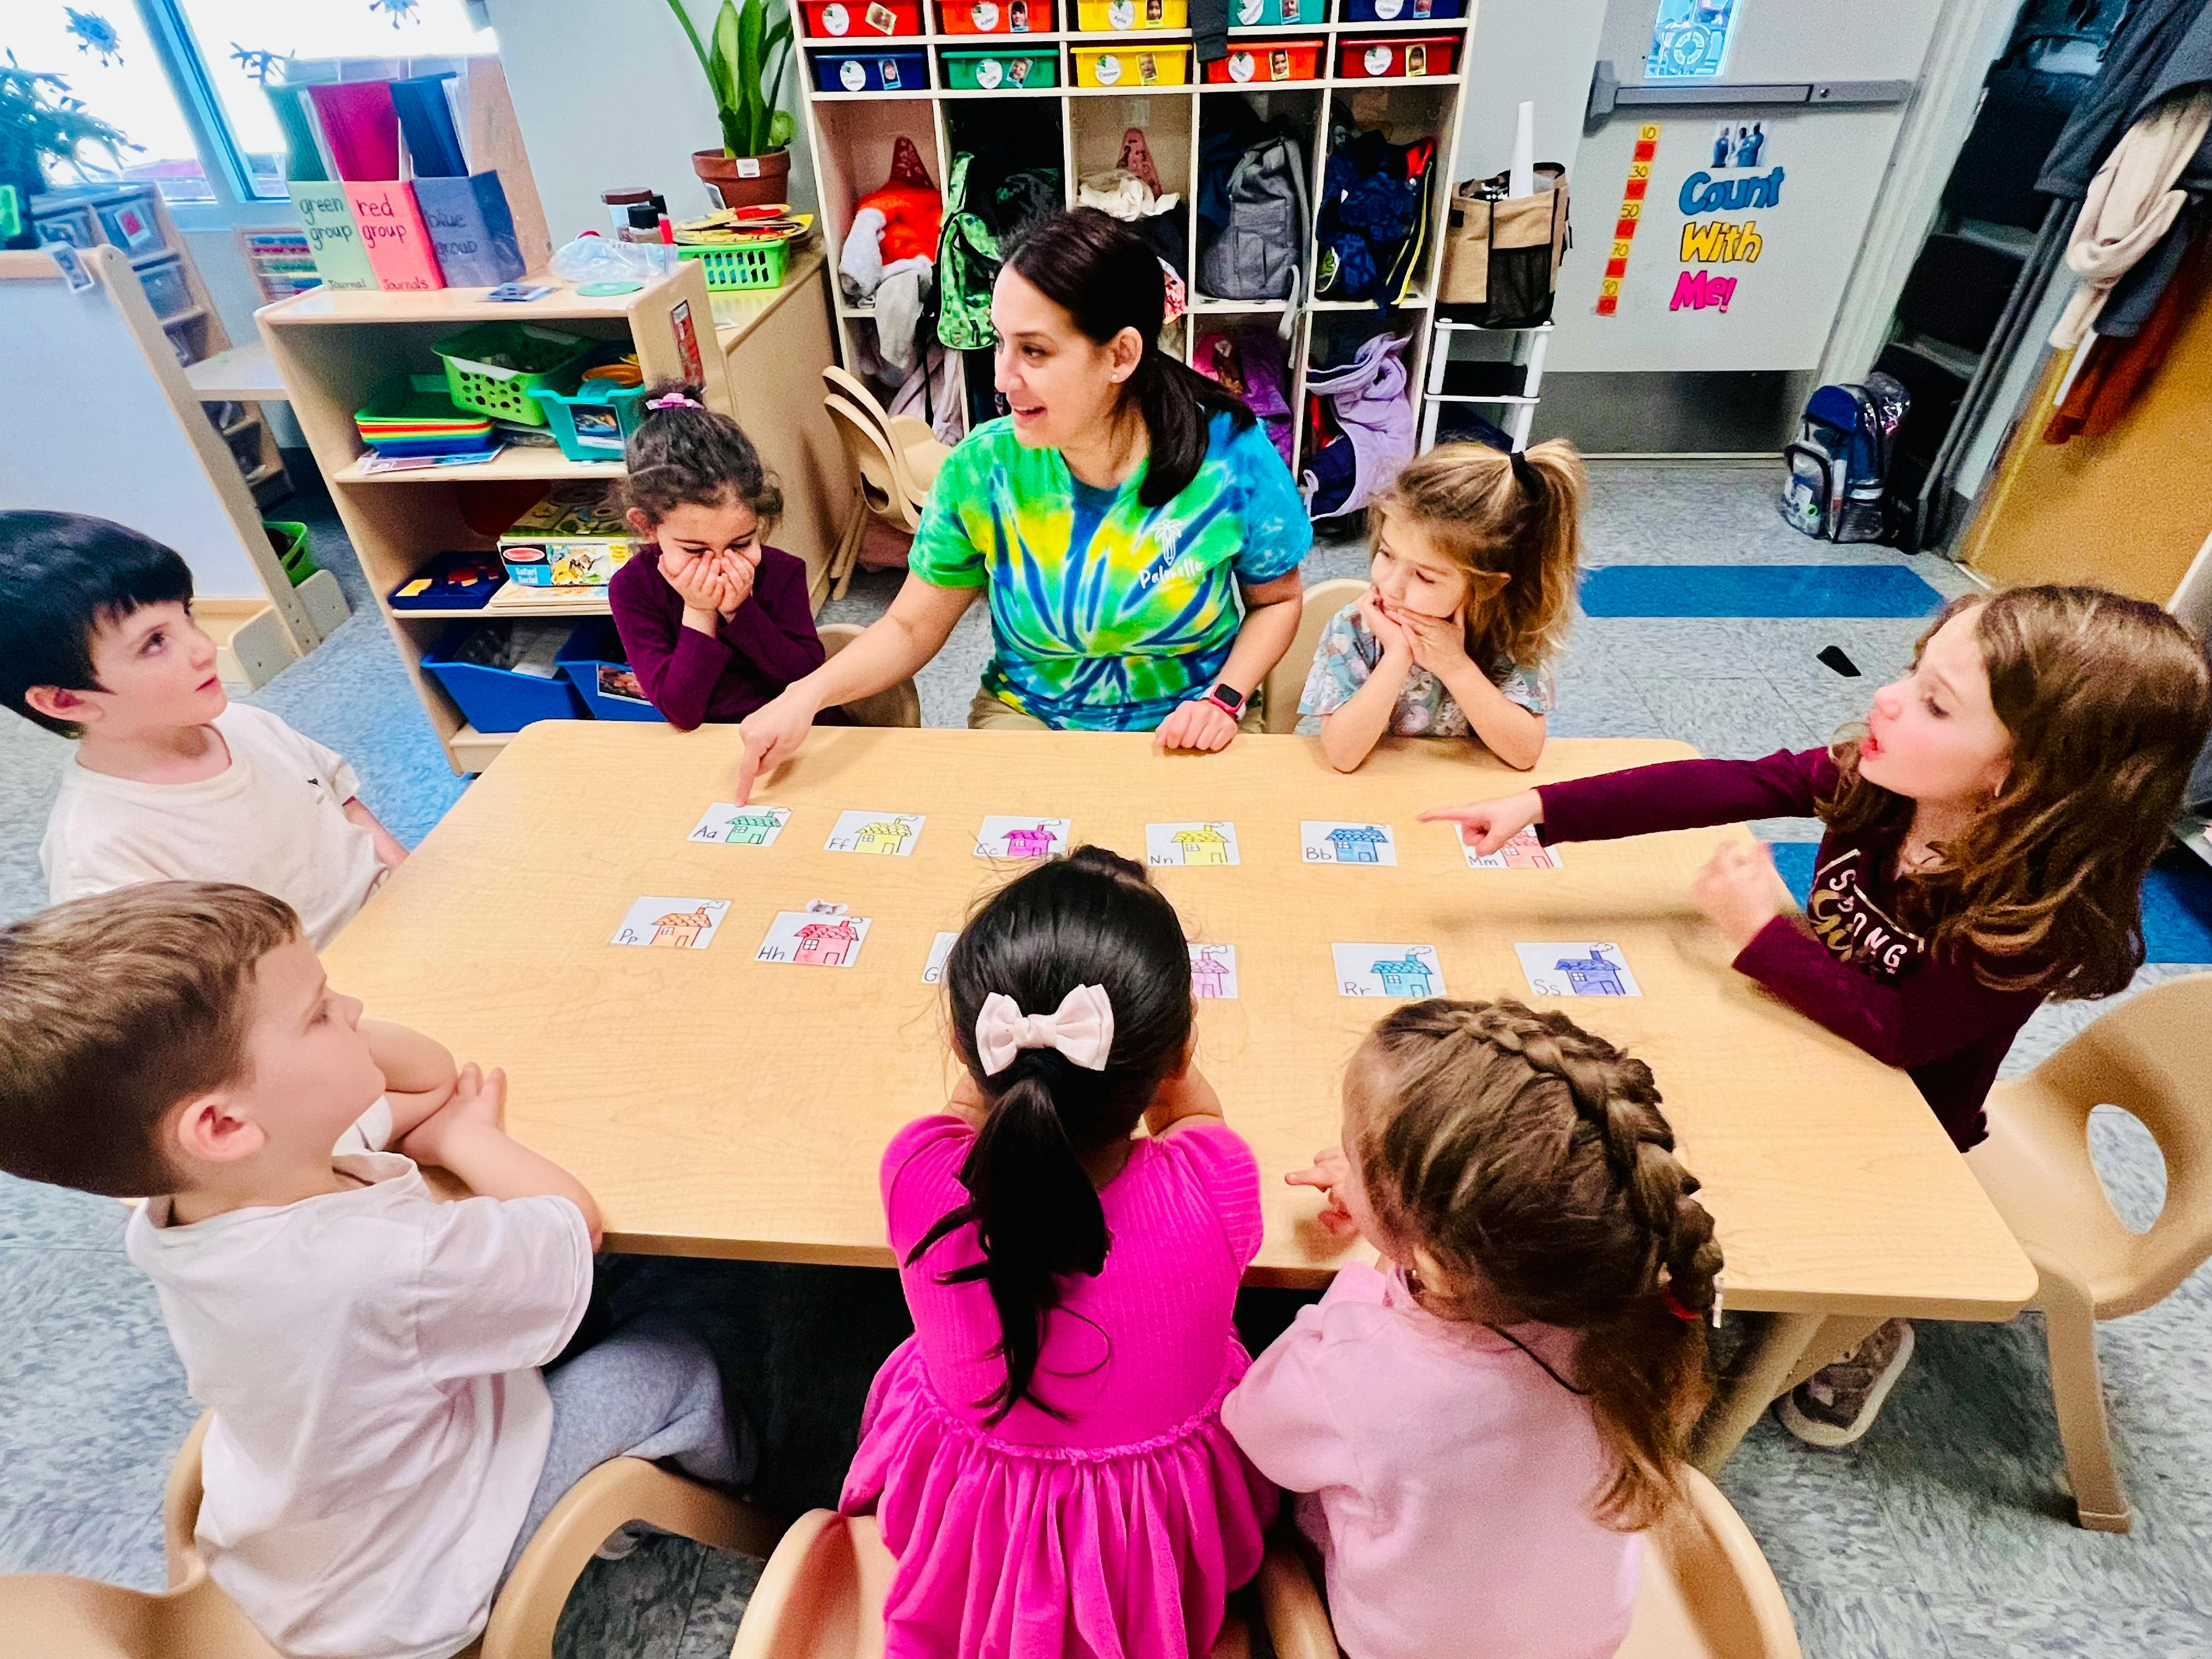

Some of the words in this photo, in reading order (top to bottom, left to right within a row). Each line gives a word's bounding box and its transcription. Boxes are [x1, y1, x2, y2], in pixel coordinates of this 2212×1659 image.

[1642, 126, 1656, 139] 10
[1628, 165, 1648, 177] 30
[1679, 166, 1785, 216] Count
[300, 196, 344, 226] green
[356, 193, 394, 217] red
[1621, 204, 1639, 218] 50
[309, 225, 353, 251] group
[363, 224, 407, 249] group
[1680, 221, 1763, 263] With
[1612, 242, 1629, 257] 70
[328, 278, 366, 290] Journal
[383, 276, 429, 291] Journals
[1602, 280, 1618, 296] 90
[1669, 270, 1737, 313] Me!
[1138, 557, 1204, 589] Palmetto
[692, 825, 718, 838] Aa
[828, 838, 850, 850] Ff
[977, 843, 998, 855] Cc
[1150, 855, 1173, 864] Nn
[1306, 847, 1331, 860] Bb
[1469, 855, 1498, 866] Mm
[619, 928, 637, 945] Pp
[758, 946, 785, 961] Hh
[1344, 981, 1370, 995] Rr
[1533, 979, 1561, 996] Ss
